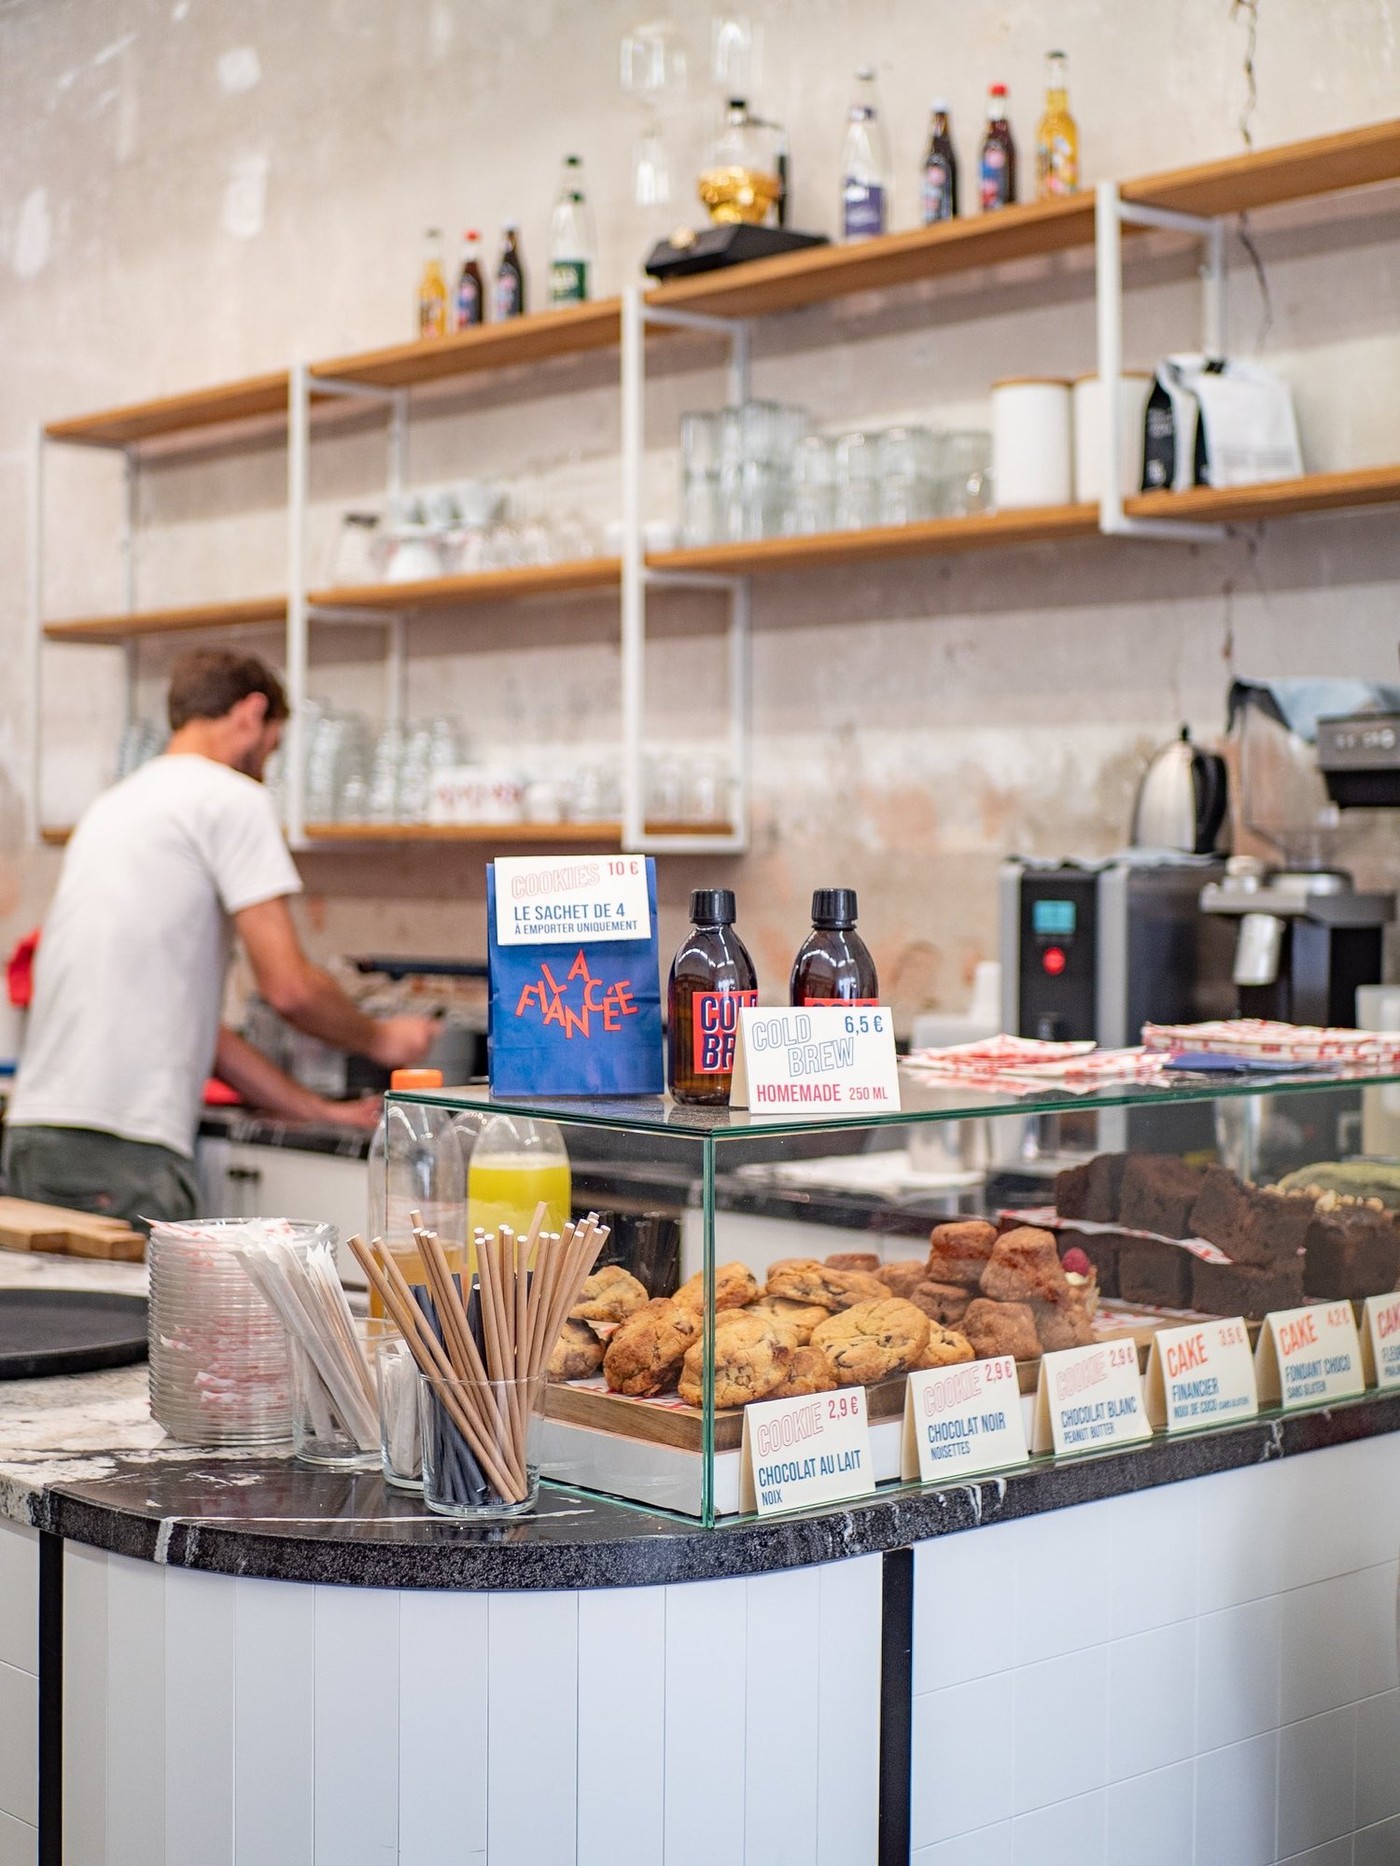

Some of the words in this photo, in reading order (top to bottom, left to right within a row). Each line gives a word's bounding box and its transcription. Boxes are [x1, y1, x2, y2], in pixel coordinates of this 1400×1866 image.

[511, 863, 600, 899] COOKIES
[608, 861, 625, 876] 10
[630, 861, 639, 875] €
[514, 905, 530, 921] LE
[535, 904, 589, 920] SACHET
[594, 903, 612, 918] DE
[616, 902, 625, 917] 4
[514, 923, 521, 935] À
[524, 922, 574, 935] EMPORTER
[577, 920, 638, 932] UNIQUEMENT
[701, 994, 757, 1033] CO
[844, 1015, 869, 1036] 6,5
[873, 1015, 884, 1033] €
[751, 1014, 812, 1051] COLD
[702, 1033, 736, 1070] BR
[787, 1036, 854, 1077] BREW
[756, 1084, 841, 1103] HOMEMADE
[849, 1087, 870, 1101] 250
[872, 1086, 888, 1100] ML
[1279, 1312, 1318, 1356] CAKE
[1377, 1302, 1400, 1339] CAK
[1167, 1332, 1208, 1378] CAKE
[1285, 1359, 1322, 1382] FONDANT
[1323, 1353, 1351, 1375] CHOCO
[985, 1362, 1003, 1383] 2,9
[1005, 1361, 1013, 1378] €
[1056, 1350, 1108, 1401] COOKIE
[923, 1365, 982, 1417] COOKIE
[1172, 1377, 1219, 1401] FINANCIER
[828, 1398, 848, 1420] 2,9
[850, 1396, 859, 1415] €
[1060, 1402, 1106, 1428] CHOCOLAT
[1107, 1396, 1138, 1418] BLANC
[757, 1401, 824, 1457] COOKIE
[928, 1416, 979, 1443] CHOCOLAT
[981, 1412, 1006, 1433] NOIR
[1063, 1427, 1089, 1444] PEANUT
[1089, 1422, 1115, 1439] BUTTER
[930, 1440, 971, 1460] NOISETTES
[758, 1458, 816, 1487] CHOCOLAT
[820, 1454, 835, 1475] AU
[837, 1450, 861, 1472] LAIT
[761, 1489, 783, 1506] NOIX
